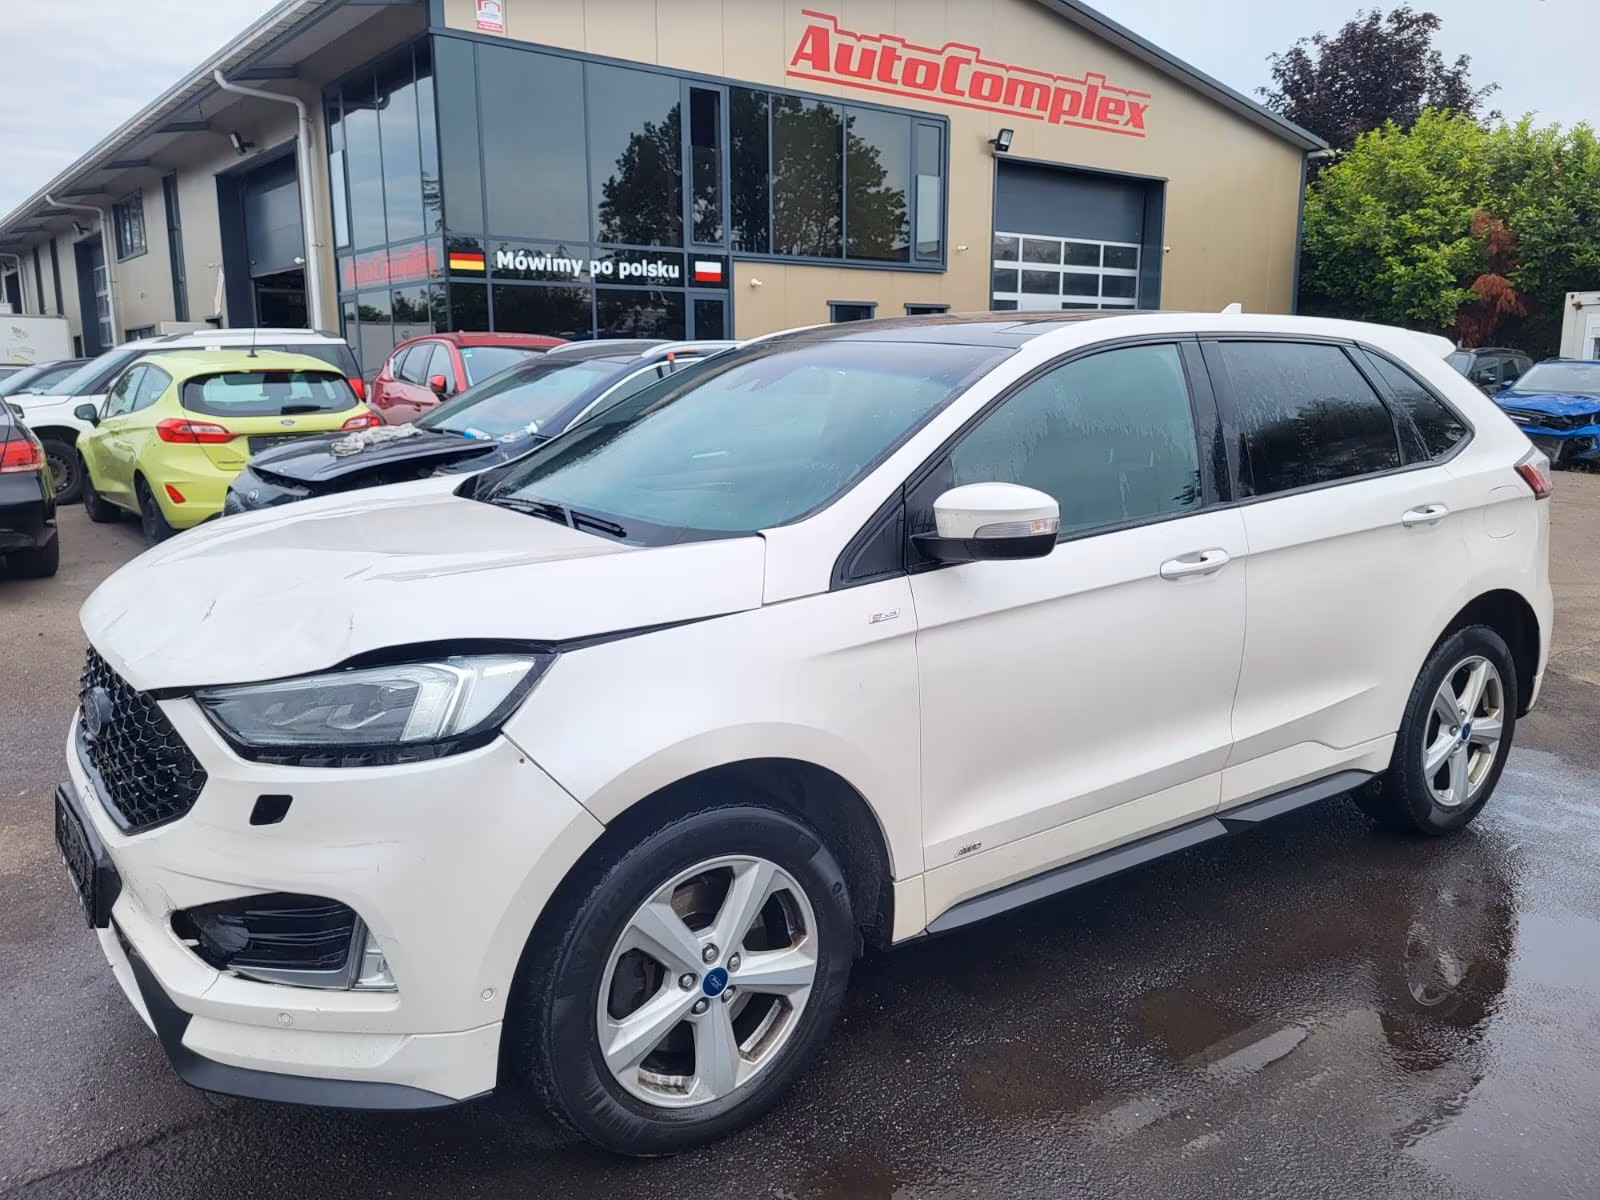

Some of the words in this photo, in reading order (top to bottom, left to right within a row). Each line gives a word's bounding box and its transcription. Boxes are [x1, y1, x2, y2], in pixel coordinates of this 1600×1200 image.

[790, 24, 1150, 129] AutoComplex
[496, 250, 583, 277] Mówimy
[589, 259, 613, 277] po
[618, 258, 680, 279] polsku
